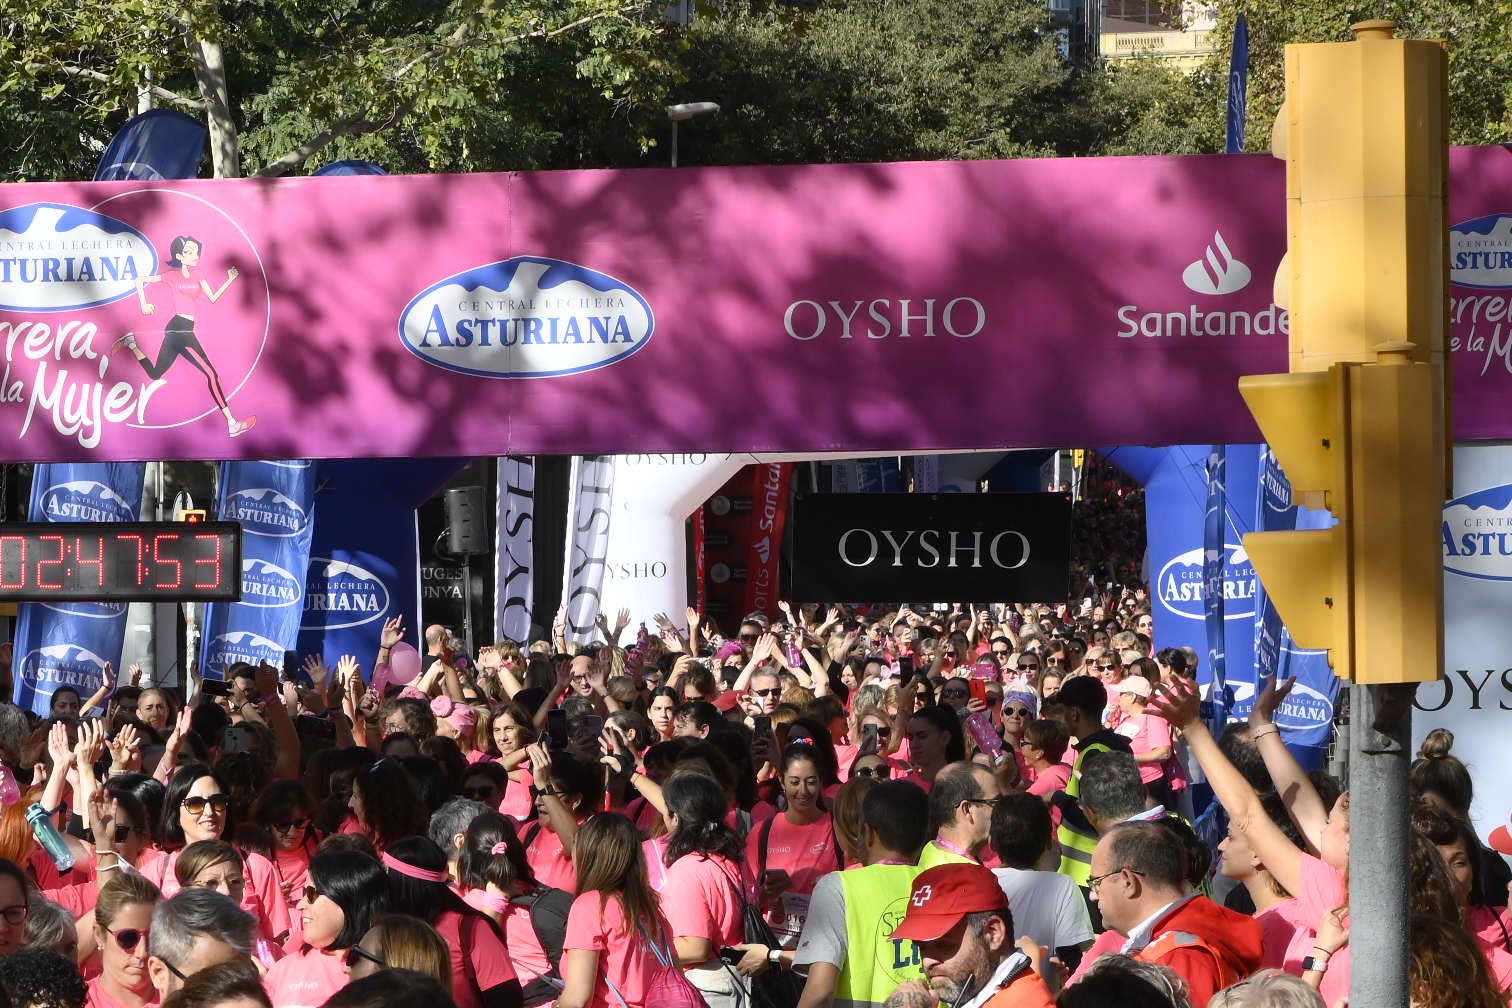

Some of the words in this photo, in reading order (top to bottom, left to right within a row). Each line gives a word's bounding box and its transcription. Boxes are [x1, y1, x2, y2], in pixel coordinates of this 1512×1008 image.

[63, 239, 135, 251] LECHERA
[1458, 240, 1509, 248] CENTRAL
[459, 299, 536, 312] CENTRAL
[545, 297, 625, 310] LECHERA
[784, 296, 986, 341] OYSHO
[419, 304, 634, 347] ASTURIANA
[1117, 303, 1289, 338] Santande
[1467, 324, 1485, 352] la
[0, 362, 25, 404] la
[19, 355, 167, 449] Mujer
[227, 502, 301, 530] ASTURIANA
[240, 500, 271, 510] CENTRAL
[502, 455, 534, 643] OYSH
[567, 456, 613, 635] OYSH
[838, 528, 1031, 569] OYSHO
[607, 562, 667, 579] YSHO
[243, 582, 296, 600] URIANA
[327, 582, 376, 591] LECHERA
[25, 662, 104, 690] ASTURIAN
[1410, 668, 1512, 712] OYS
[1274, 702, 1327, 721] URIANA
